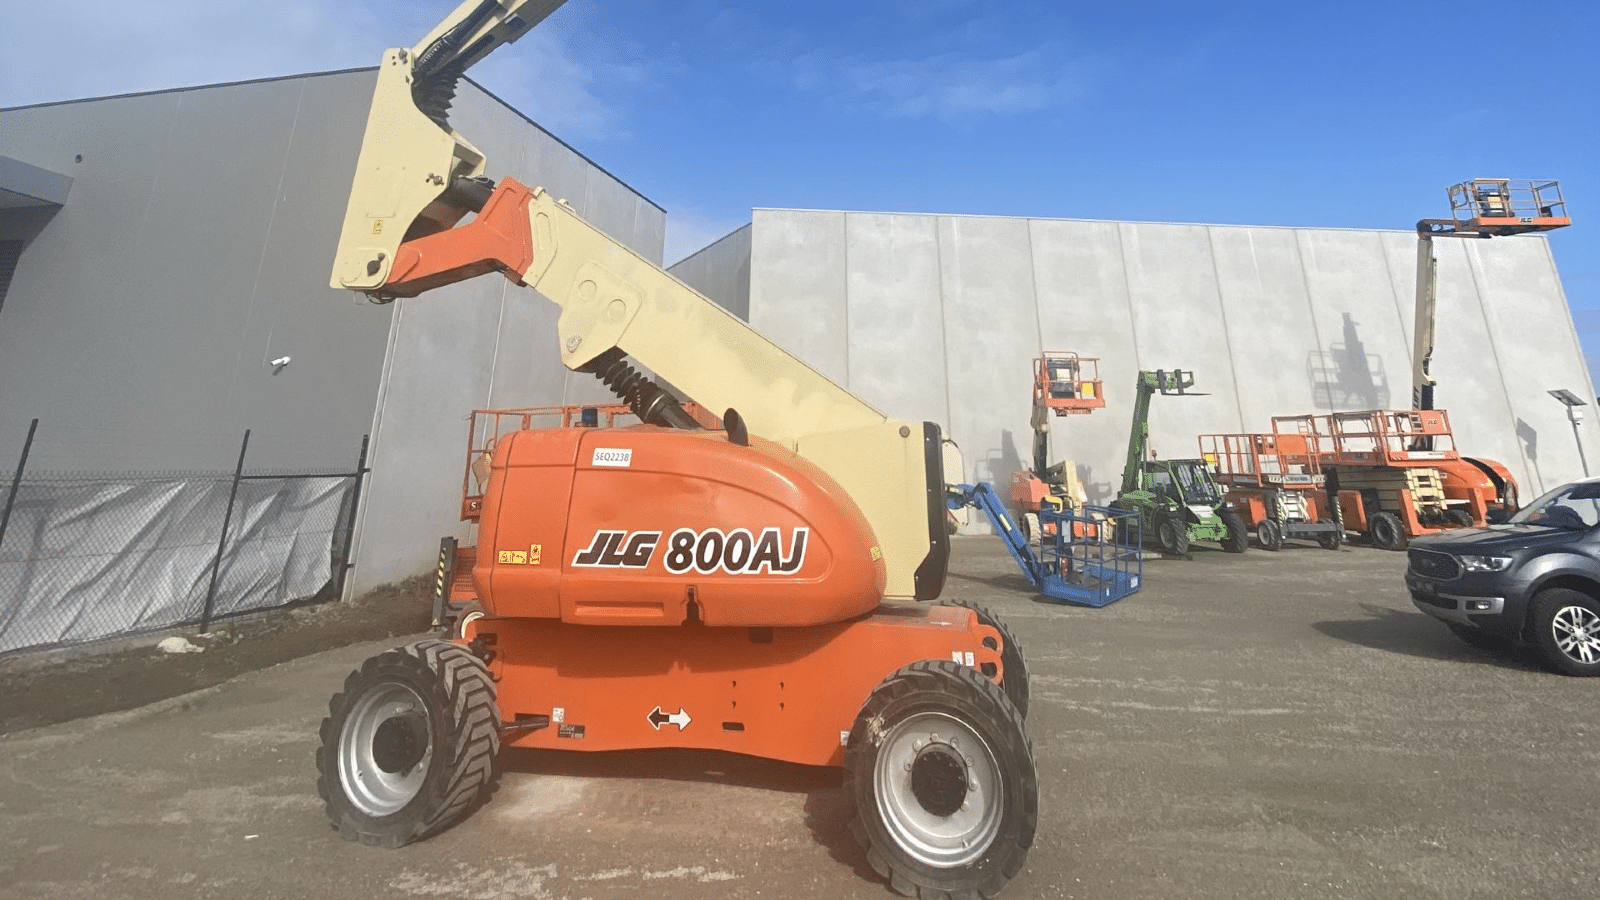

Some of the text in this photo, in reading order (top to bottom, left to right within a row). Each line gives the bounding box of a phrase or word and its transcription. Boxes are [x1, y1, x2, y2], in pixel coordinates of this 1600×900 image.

[595, 452, 630, 462] SEQ2238
[572, 528, 809, 575] JLG 800AJ
